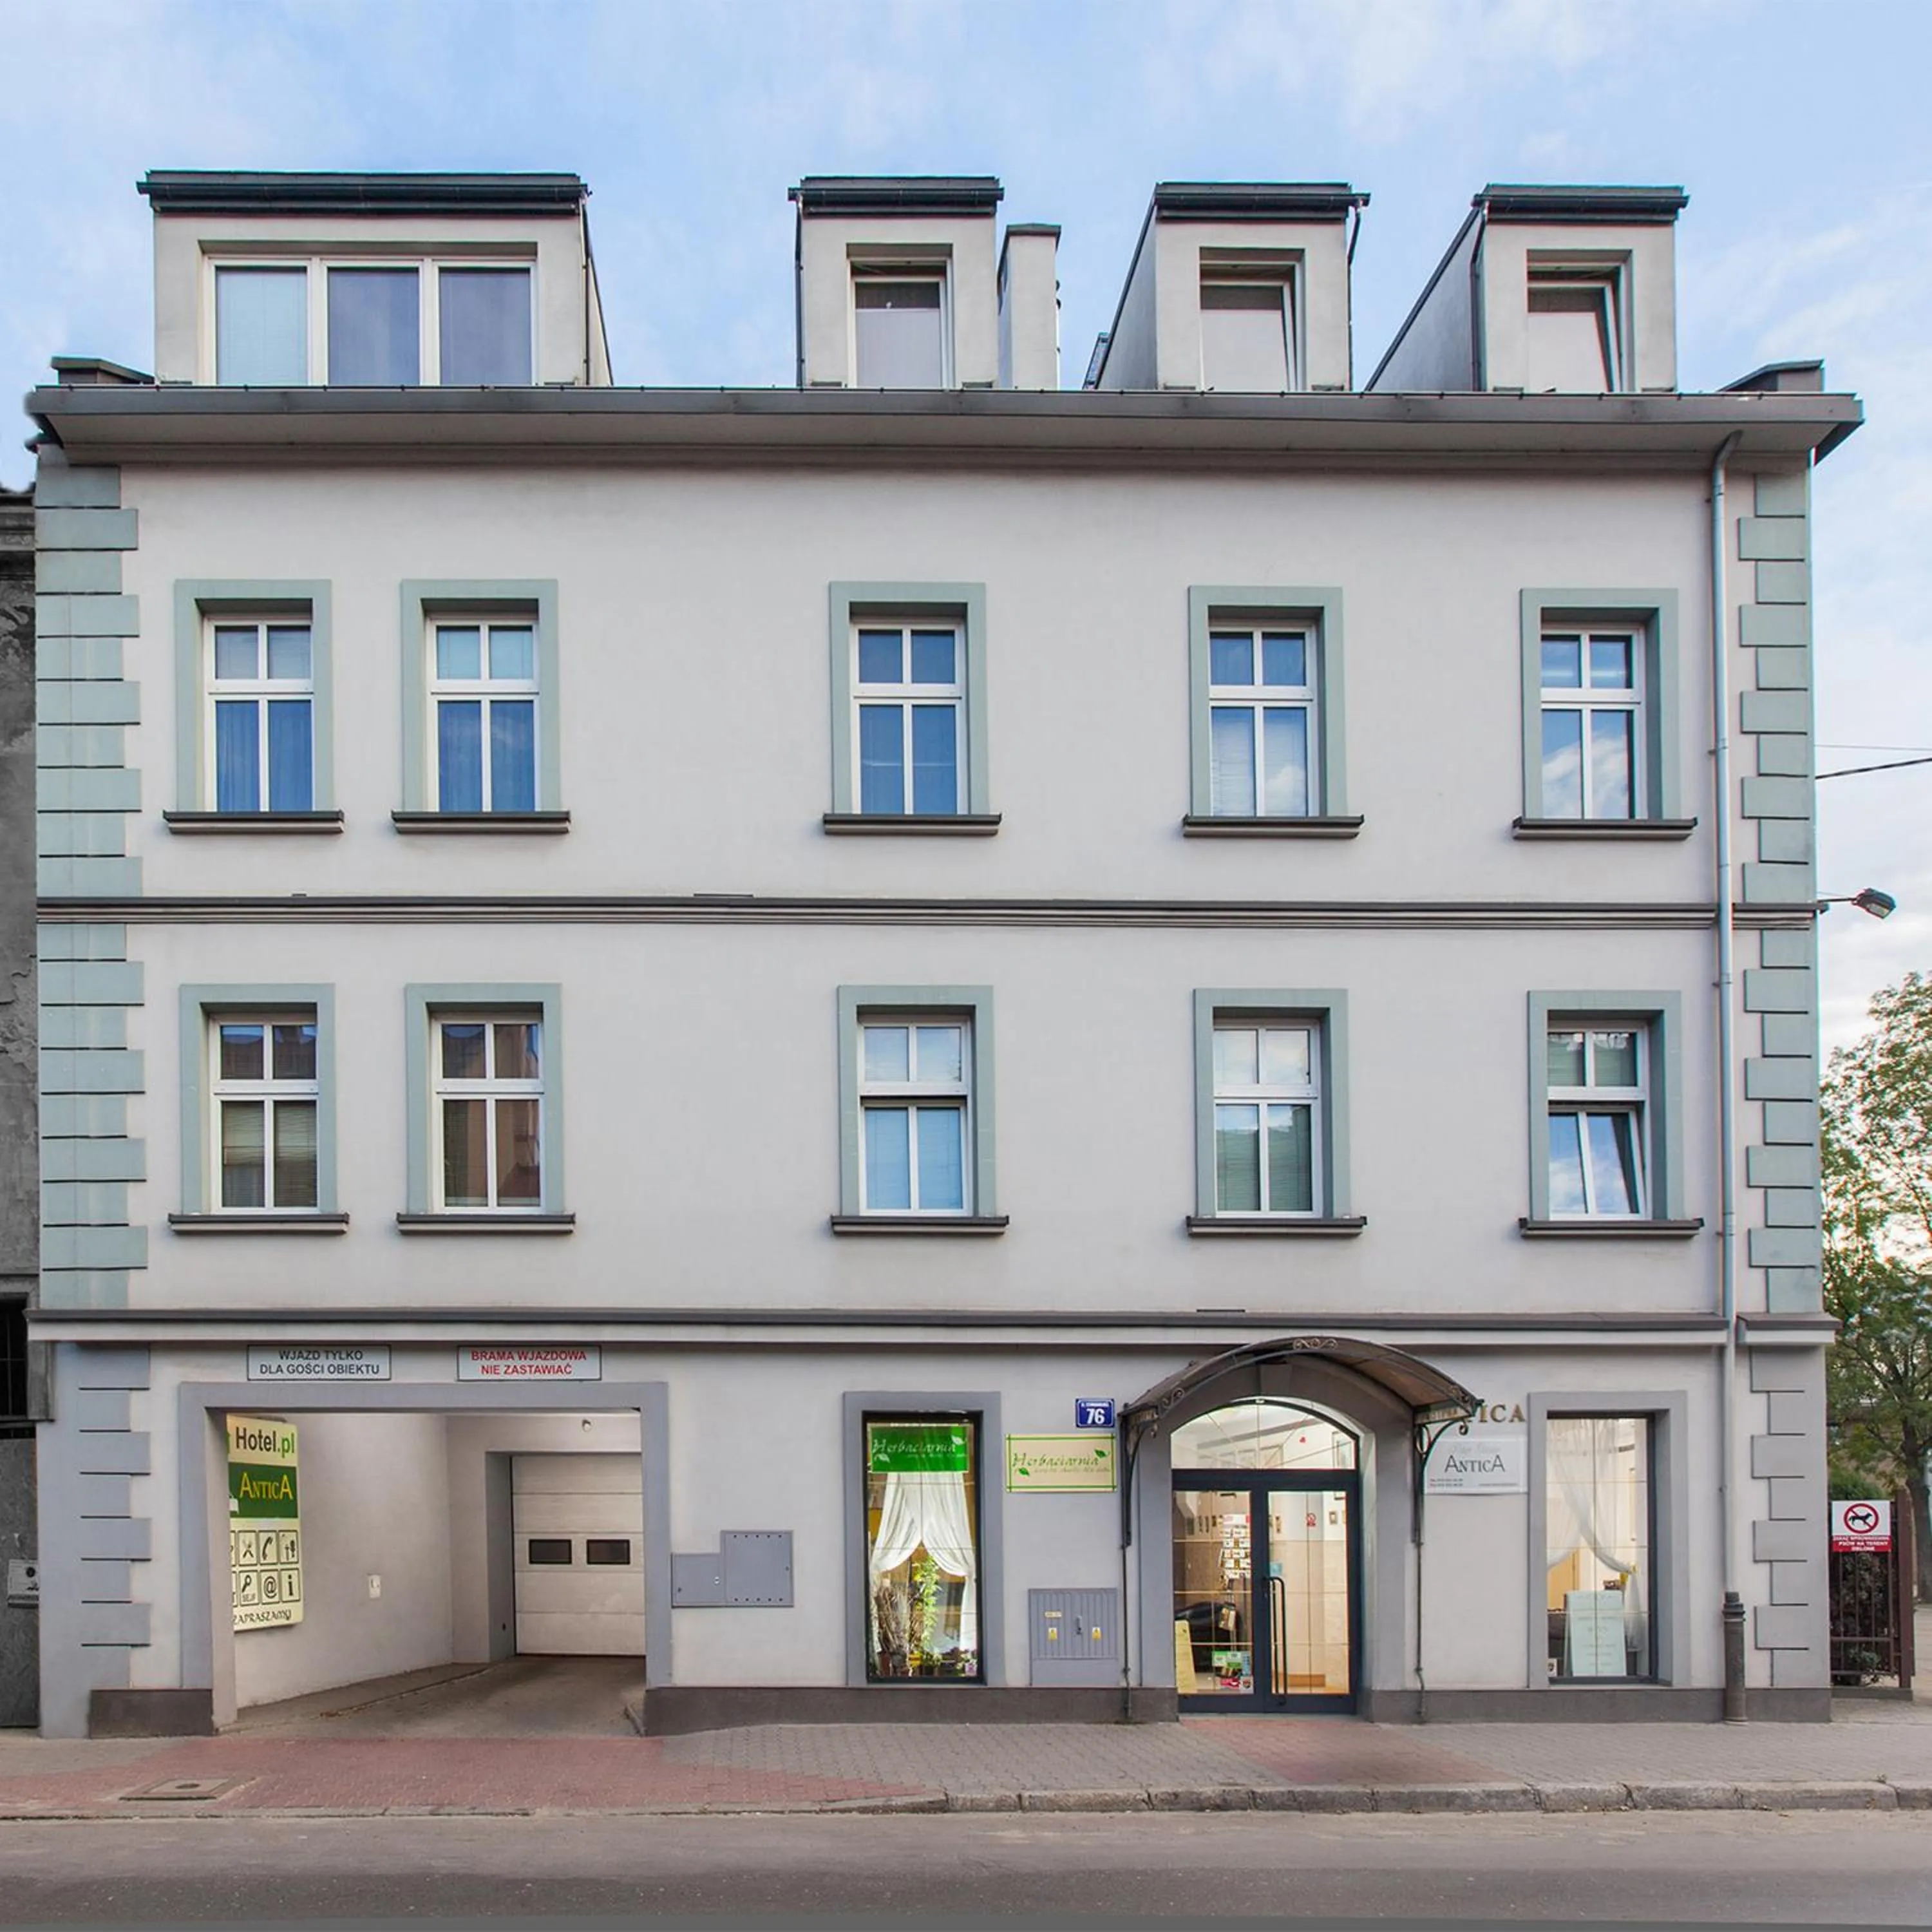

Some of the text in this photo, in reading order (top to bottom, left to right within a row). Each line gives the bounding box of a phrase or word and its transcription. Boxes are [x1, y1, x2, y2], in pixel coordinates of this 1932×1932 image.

[279, 1350, 363, 1361] WJAZD TYLKO
[471, 1350, 587, 1361] BRAMA WJAZDOWA
[260, 1363, 379, 1374] DLA GOŚCI OBIEKTU
[480, 1363, 573, 1375] NIE ZASTAWIAĆ
[1086, 1408, 1106, 1425] 76
[1469, 1404, 1526, 1423] ICA
[236, 1426, 294, 1459] Hotel.pl
